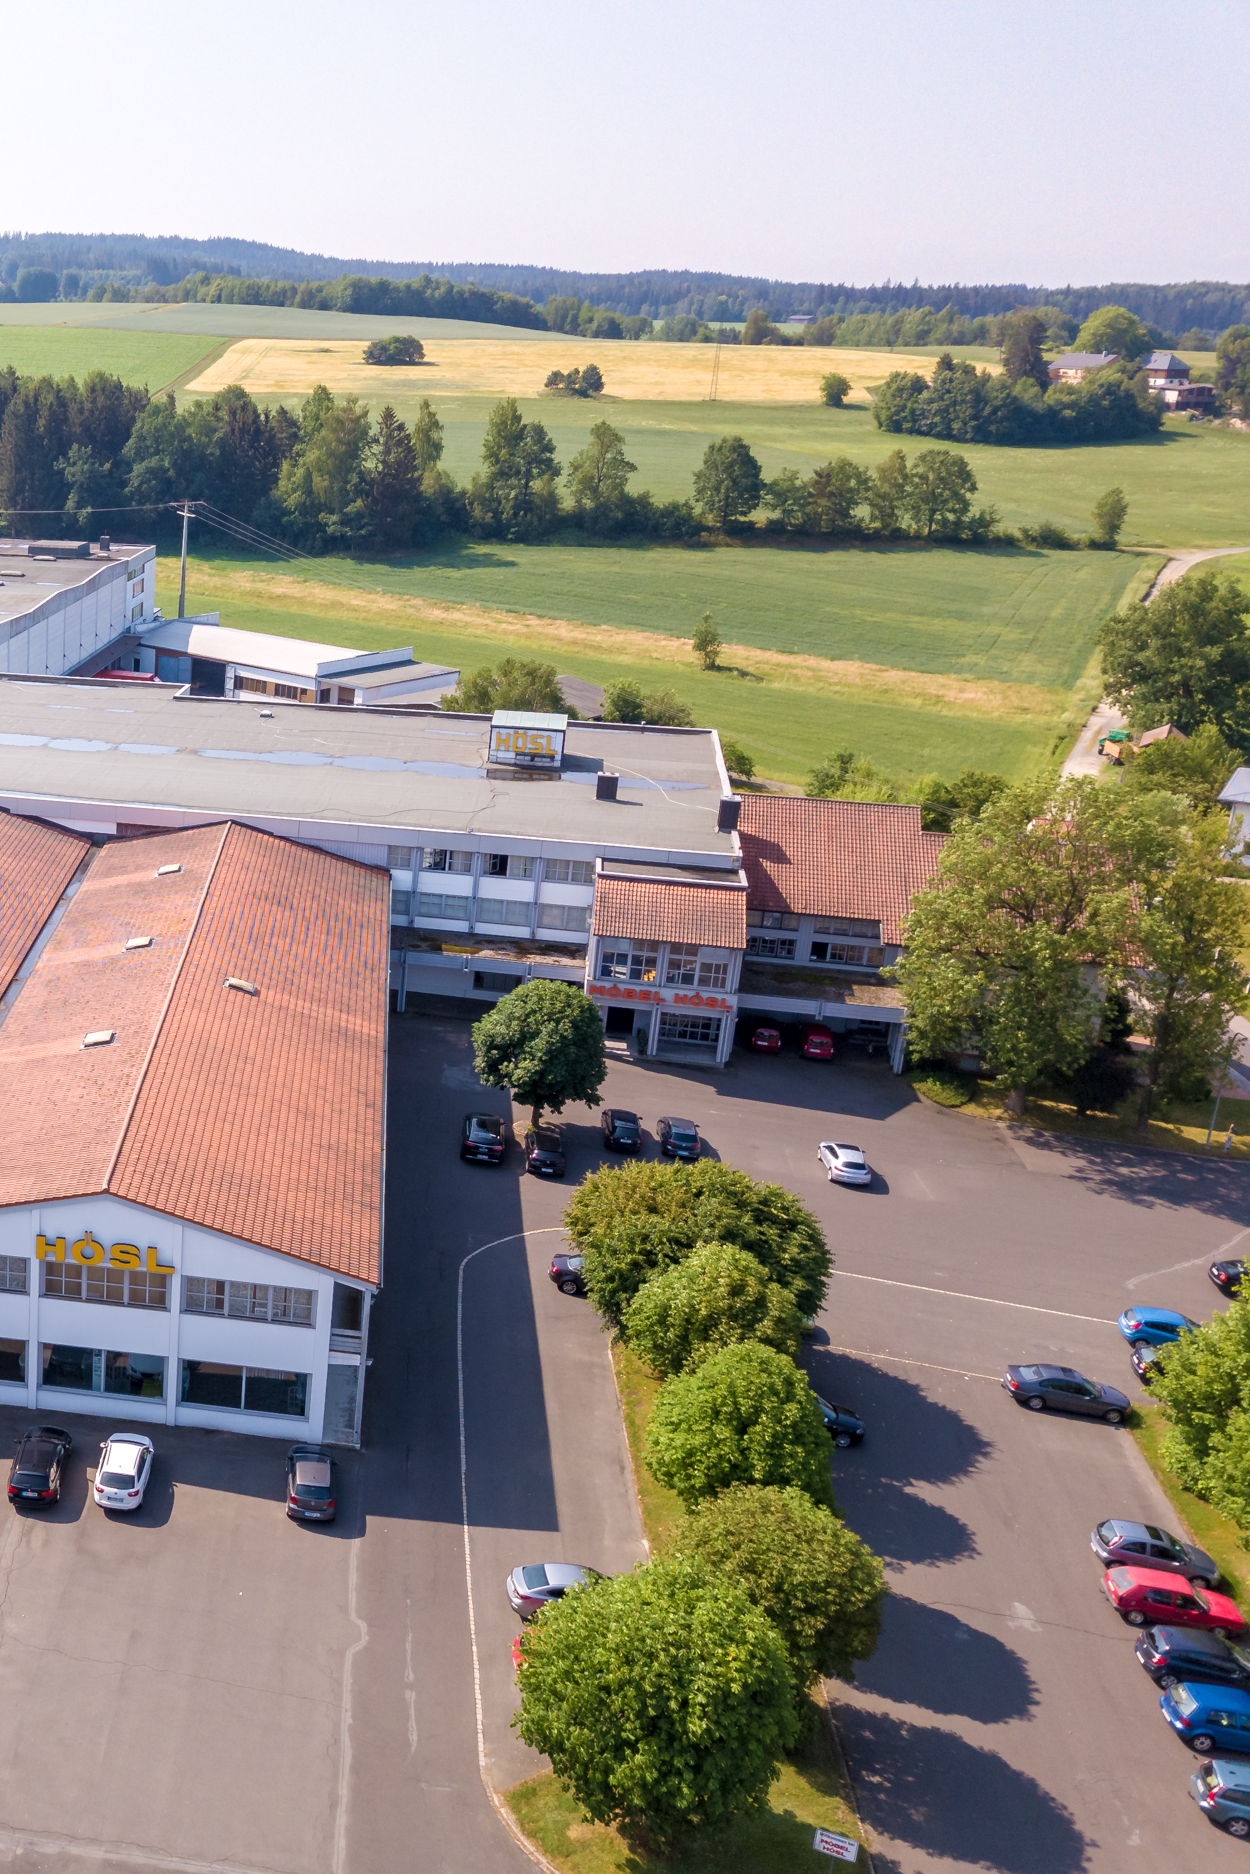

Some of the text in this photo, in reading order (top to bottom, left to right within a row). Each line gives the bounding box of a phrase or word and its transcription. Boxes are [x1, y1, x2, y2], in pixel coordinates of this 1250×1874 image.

[495, 730, 558, 755] HÖSL
[588, 983, 734, 1011] MÖBEL HÖSL
[36, 1230, 176, 1274] HÖSL
[820, 1839, 850, 1852] MÖBEL
[823, 1846, 846, 1857] HÖSL
